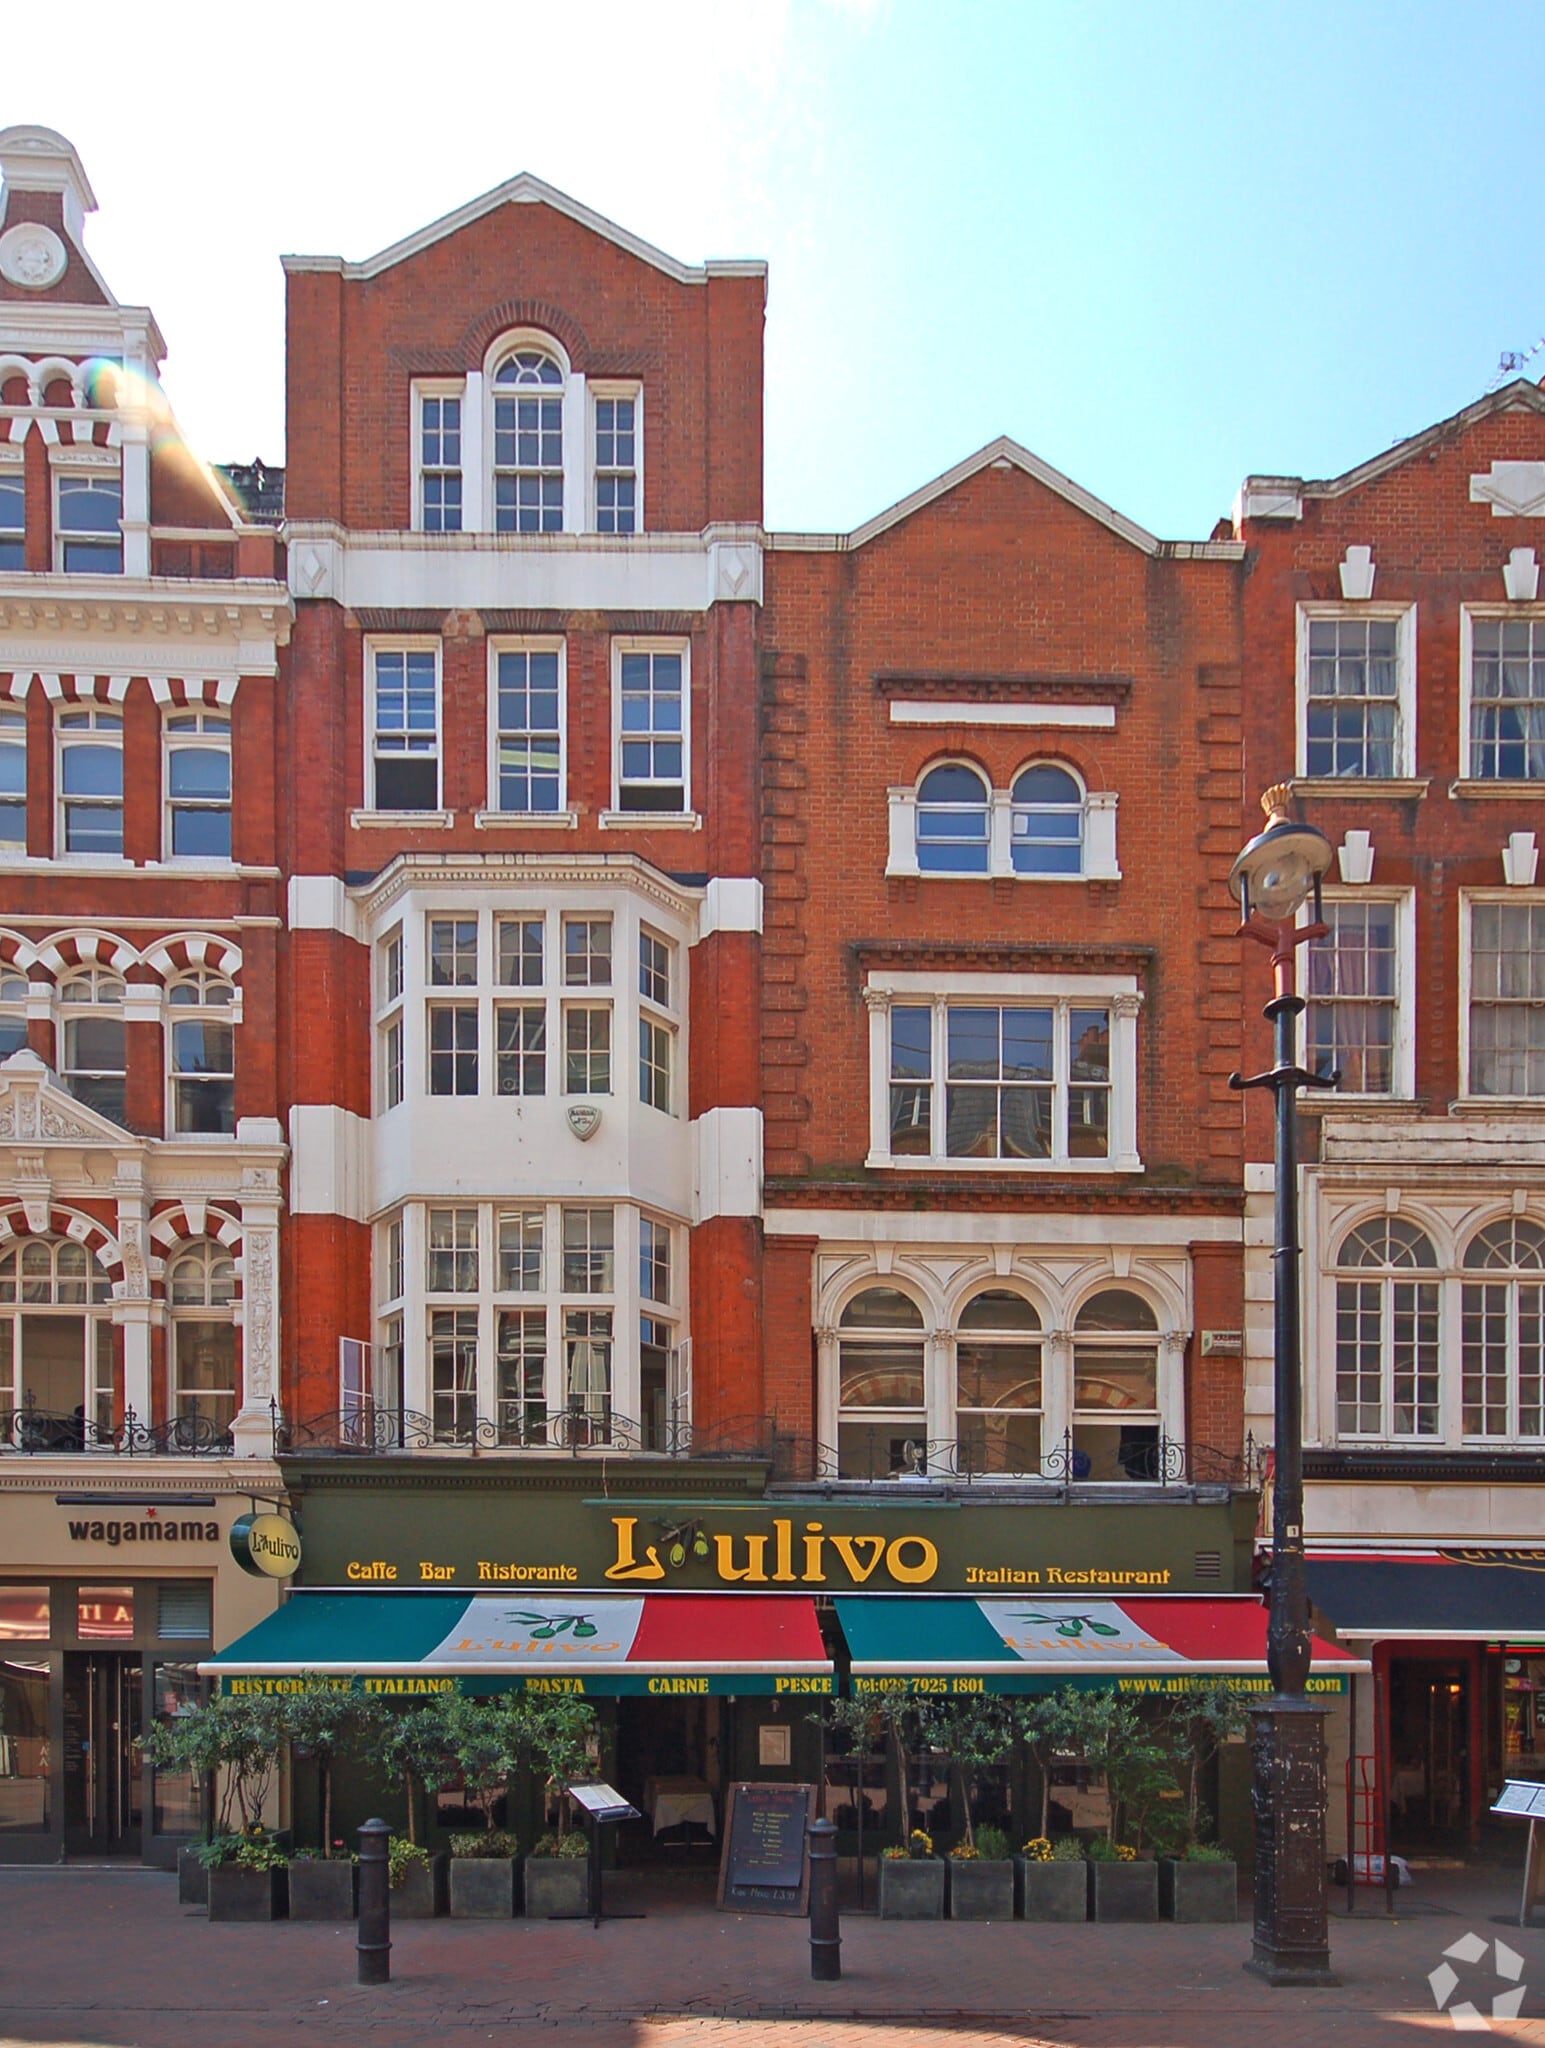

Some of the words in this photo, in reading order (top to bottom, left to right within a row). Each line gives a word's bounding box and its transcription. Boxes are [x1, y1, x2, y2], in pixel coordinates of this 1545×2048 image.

[68, 1519, 220, 1546] wagamama
[346, 1560, 398, 1582] Caffe
[418, 1561, 456, 1581] Bar
[476, 1561, 578, 1581] Ristorante
[965, 1566, 1041, 1585] Italian
[1045, 1567, 1172, 1585] Restaurant
[364, 1678, 455, 1695] ITALIANO
[525, 1678, 586, 1695] PASTA
[648, 1678, 710, 1694] CARNE
[775, 1677, 833, 1694] PESCE
[911, 1677, 948, 1694] 7925
[952, 1677, 985, 1694] 1801
